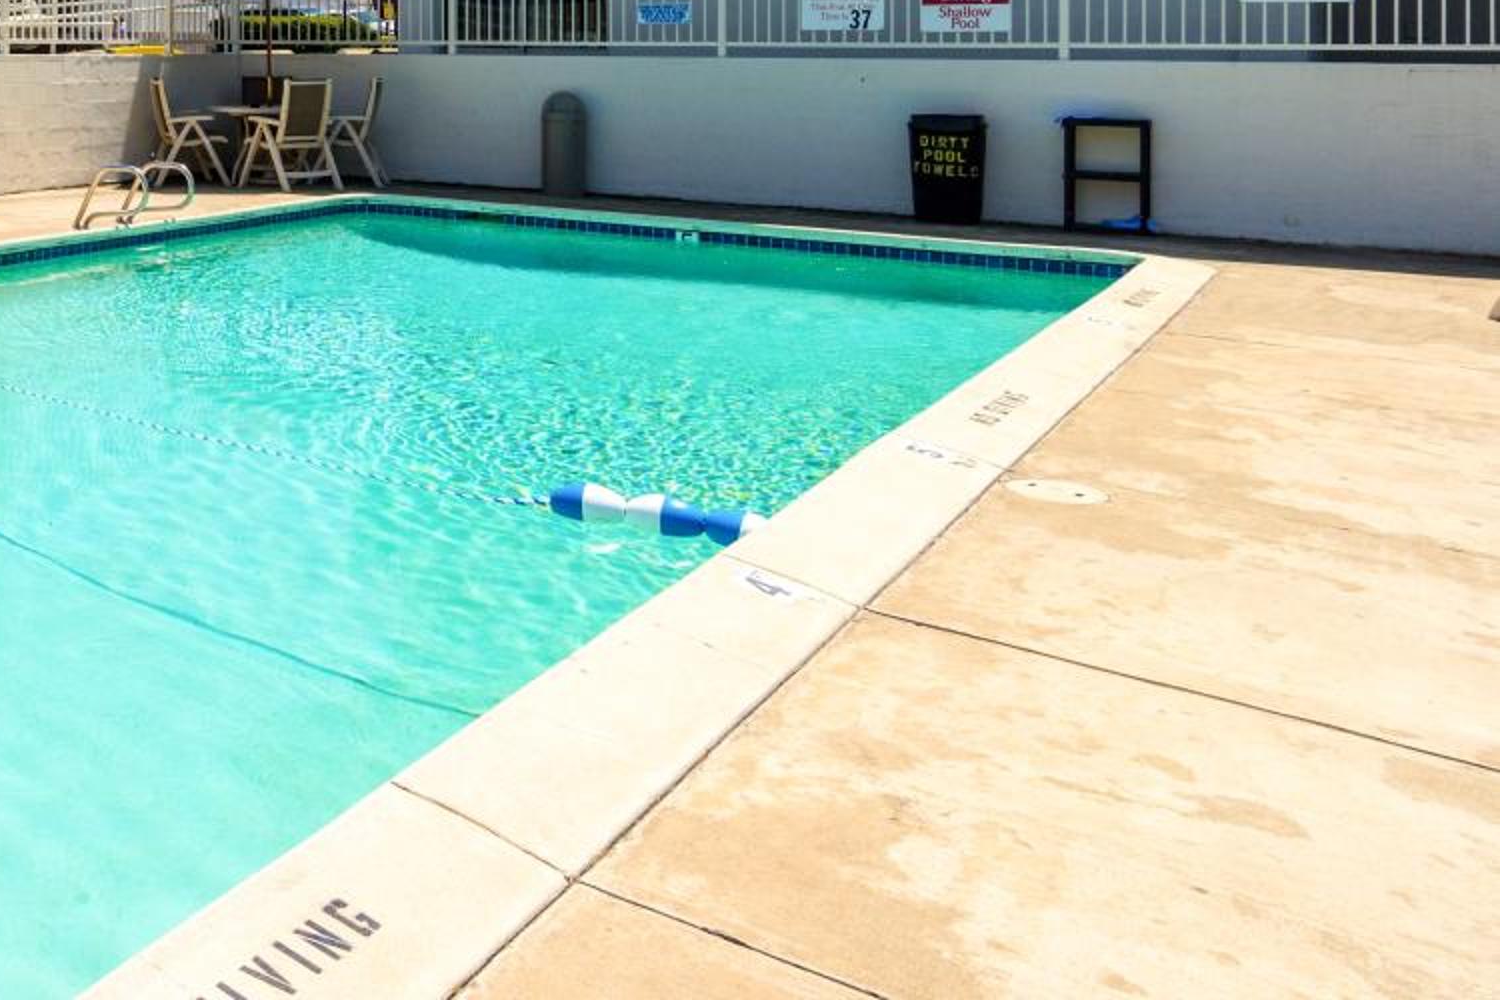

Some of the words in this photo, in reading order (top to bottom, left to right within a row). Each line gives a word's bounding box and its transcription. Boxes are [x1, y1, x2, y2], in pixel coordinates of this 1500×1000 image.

[938, 6, 992, 18] Shallow
[850, 9, 871, 29] 37
[950, 18, 980, 29] Pool
[920, 135, 969, 149] DIRTY
[924, 149, 965, 162] POOL
[196, 898, 381, 1000] IVING
